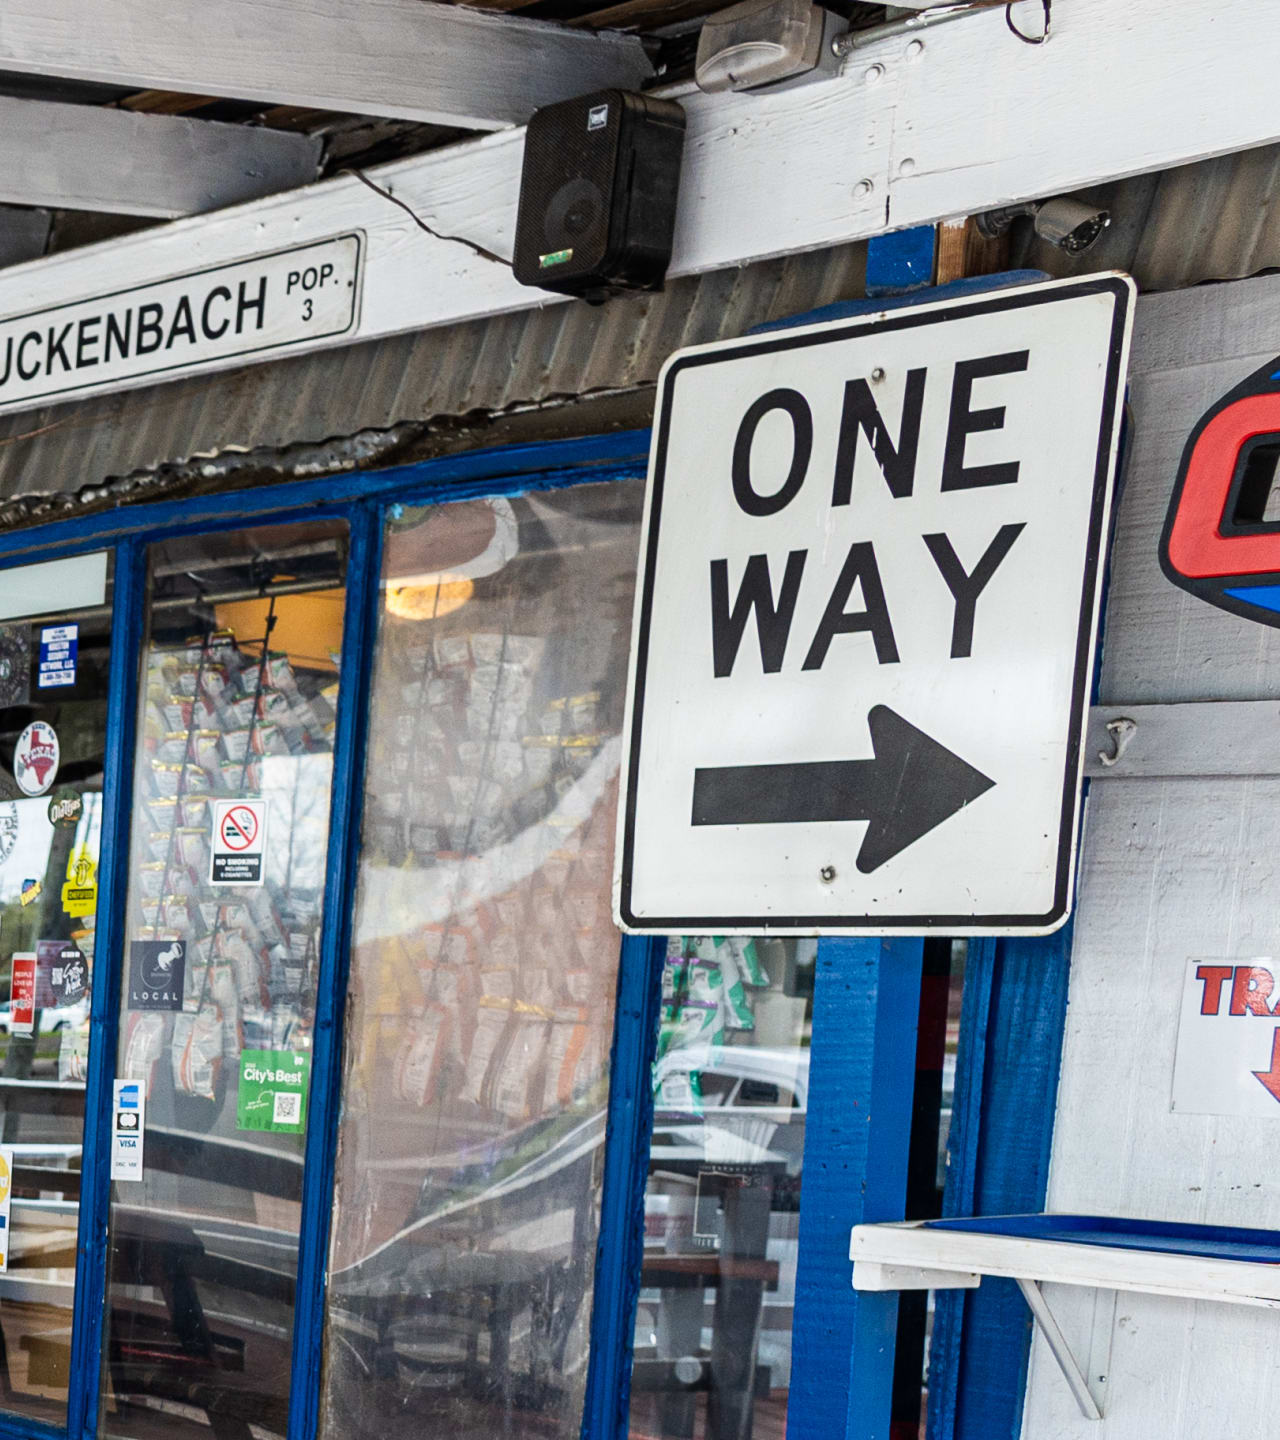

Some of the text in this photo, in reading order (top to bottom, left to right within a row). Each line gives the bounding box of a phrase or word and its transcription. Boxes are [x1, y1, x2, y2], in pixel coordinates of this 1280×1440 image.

[285, 263, 339, 295] POP.
[301, 298, 313, 321] 3
[731, 349, 1030, 517] ONE
[709, 521, 1028, 679] WAY
[215, 857, 259, 866] NO SMOKING
[133, 991, 178, 1001] LOCAL
[1195, 965, 1280, 1016] TR
[243, 1068, 302, 1084] City's Best
[119, 1140, 137, 1148] VISA
